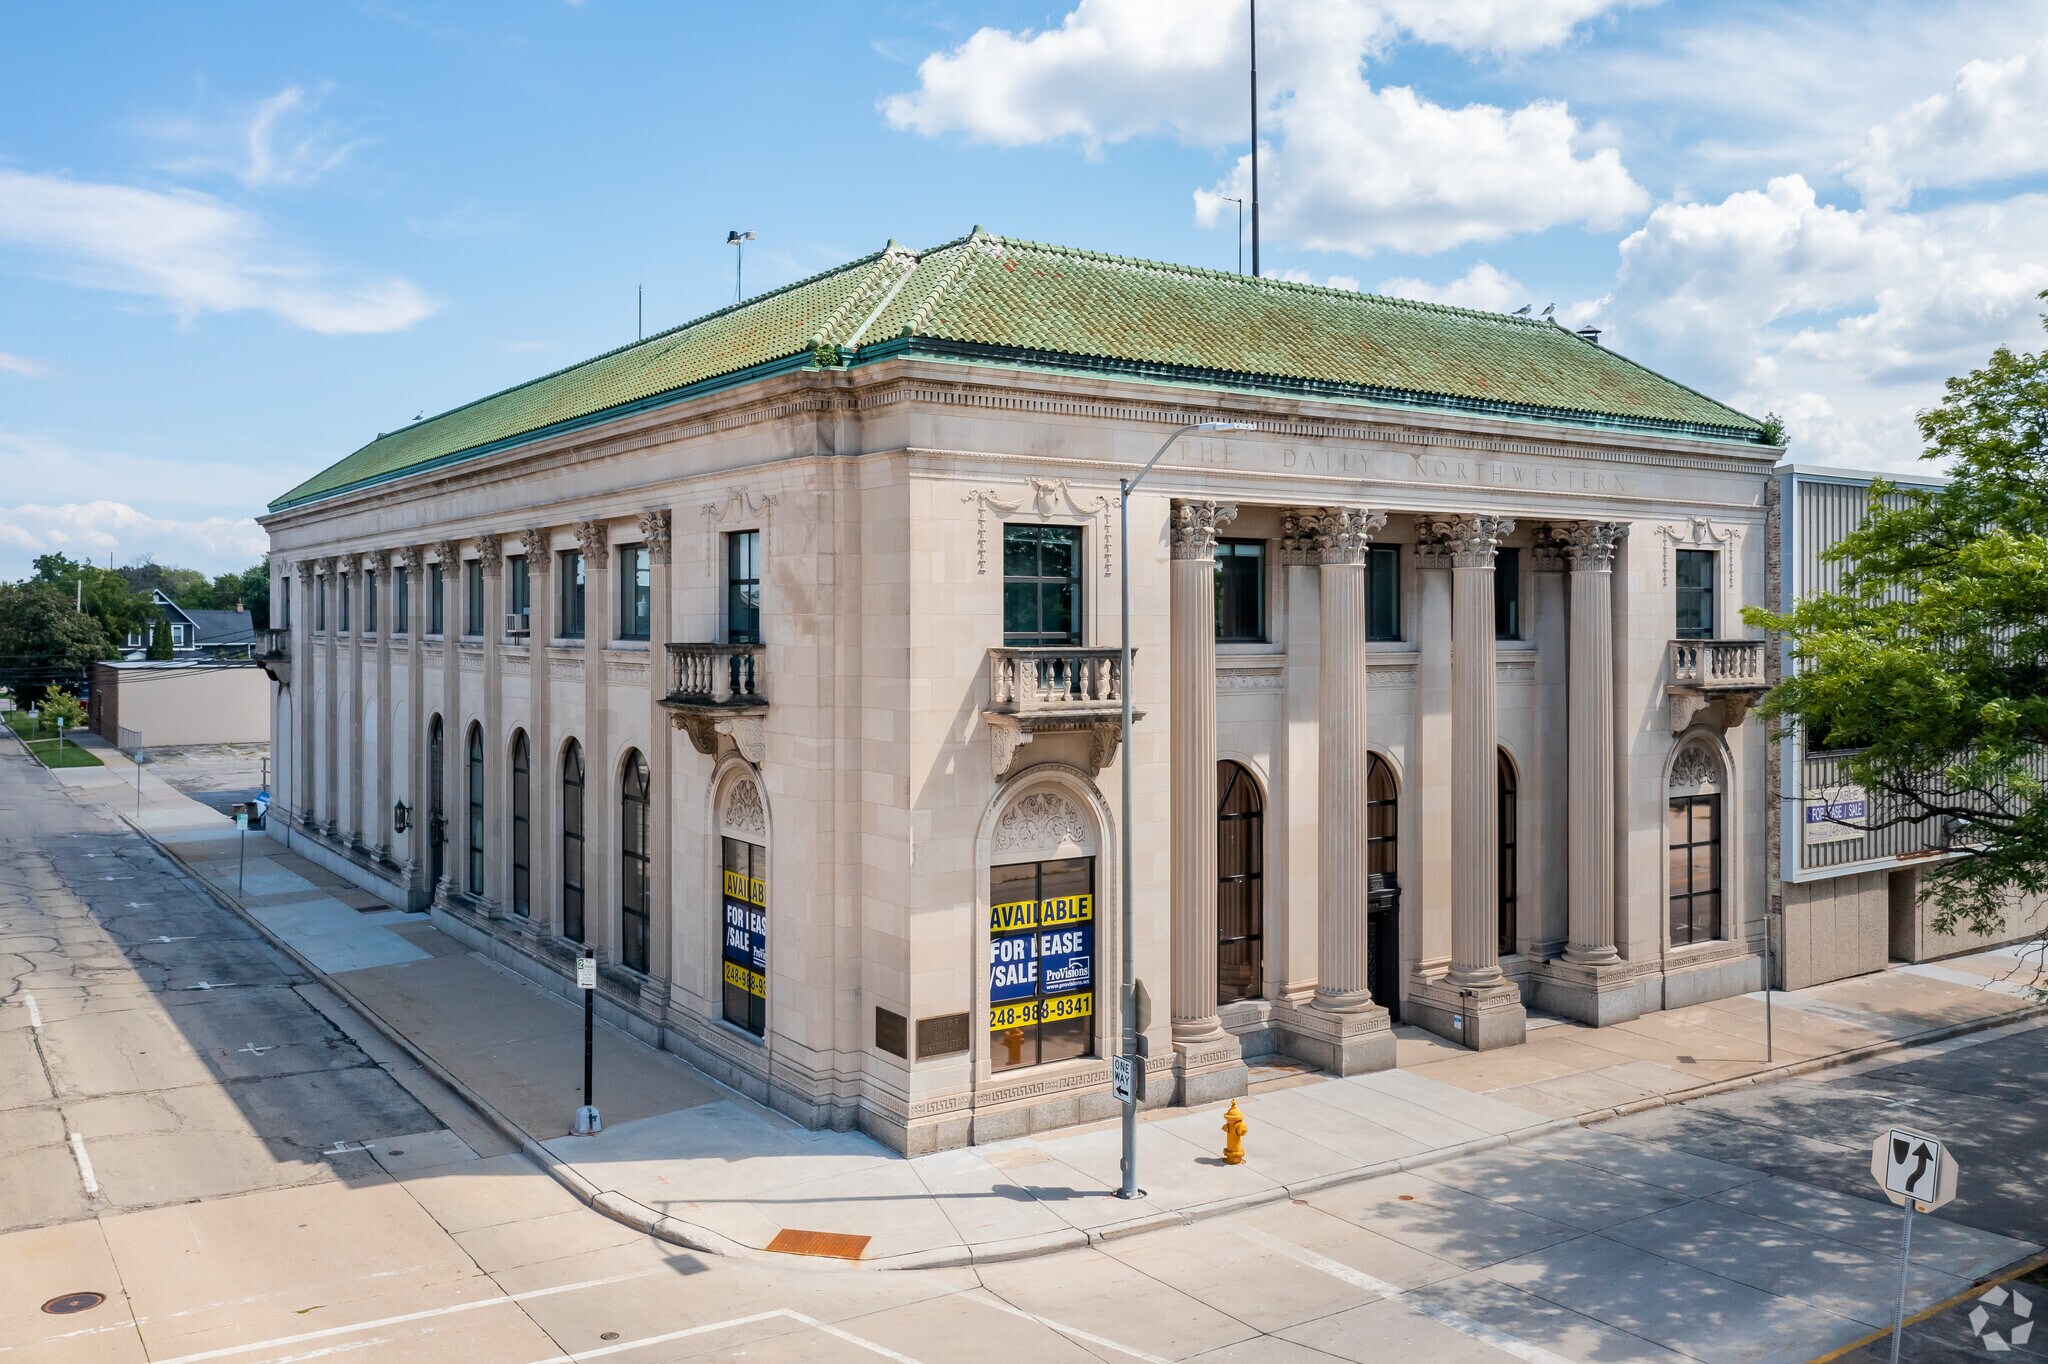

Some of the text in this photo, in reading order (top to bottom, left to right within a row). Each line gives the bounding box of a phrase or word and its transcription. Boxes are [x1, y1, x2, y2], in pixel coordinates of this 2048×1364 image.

[1177, 440, 1626, 492] THE DAILY NORTHWESTERN
[1848, 802, 1863, 817] SALE
[727, 904, 744, 928] FOR
[990, 897, 1088, 928] AVAILABLE
[726, 926, 750, 952] /SALE
[990, 931, 1083, 964] FOR LEASE
[989, 961, 1038, 991] /SALE
[1046, 966, 1088, 981] ProVisions
[990, 996, 1089, 1028] 248-988-9341
[920, 1038, 967, 1053] NORTHWESTERN
[1115, 1059, 1130, 1075] ONE
[1115, 1070, 1130, 1086] WAY
